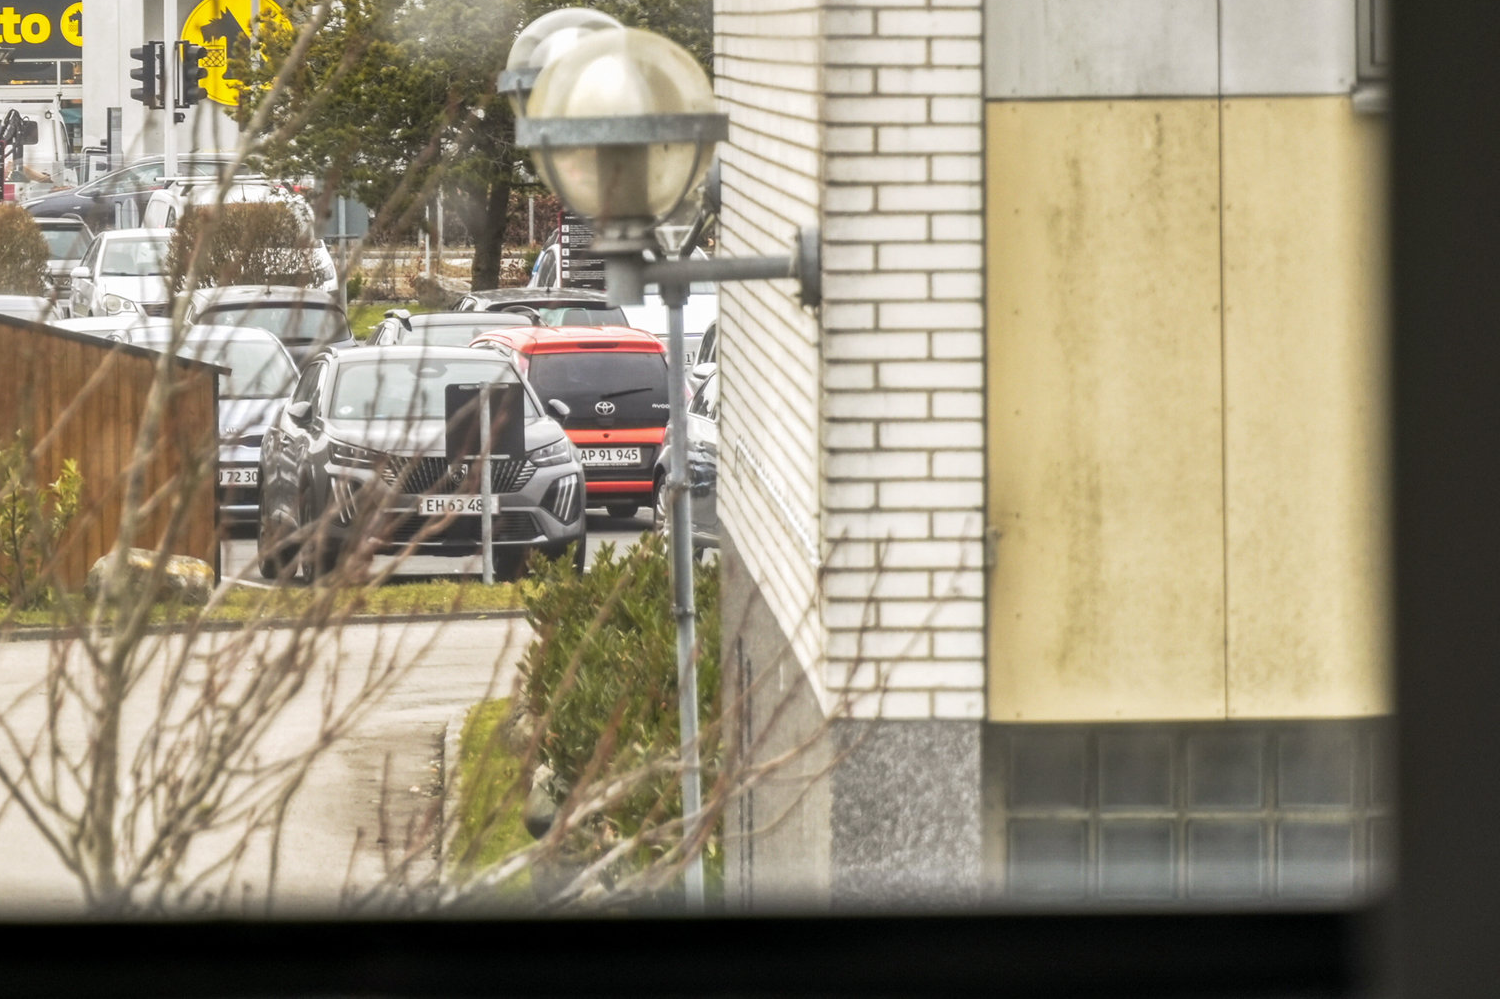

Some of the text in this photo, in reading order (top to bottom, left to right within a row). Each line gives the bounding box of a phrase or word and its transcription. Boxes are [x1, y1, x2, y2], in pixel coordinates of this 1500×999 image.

[580, 449, 638, 461] AP 91 945
[226, 471, 241, 483] 72
[426, 499, 445, 512] EH
[467, 499, 484, 512] 48
